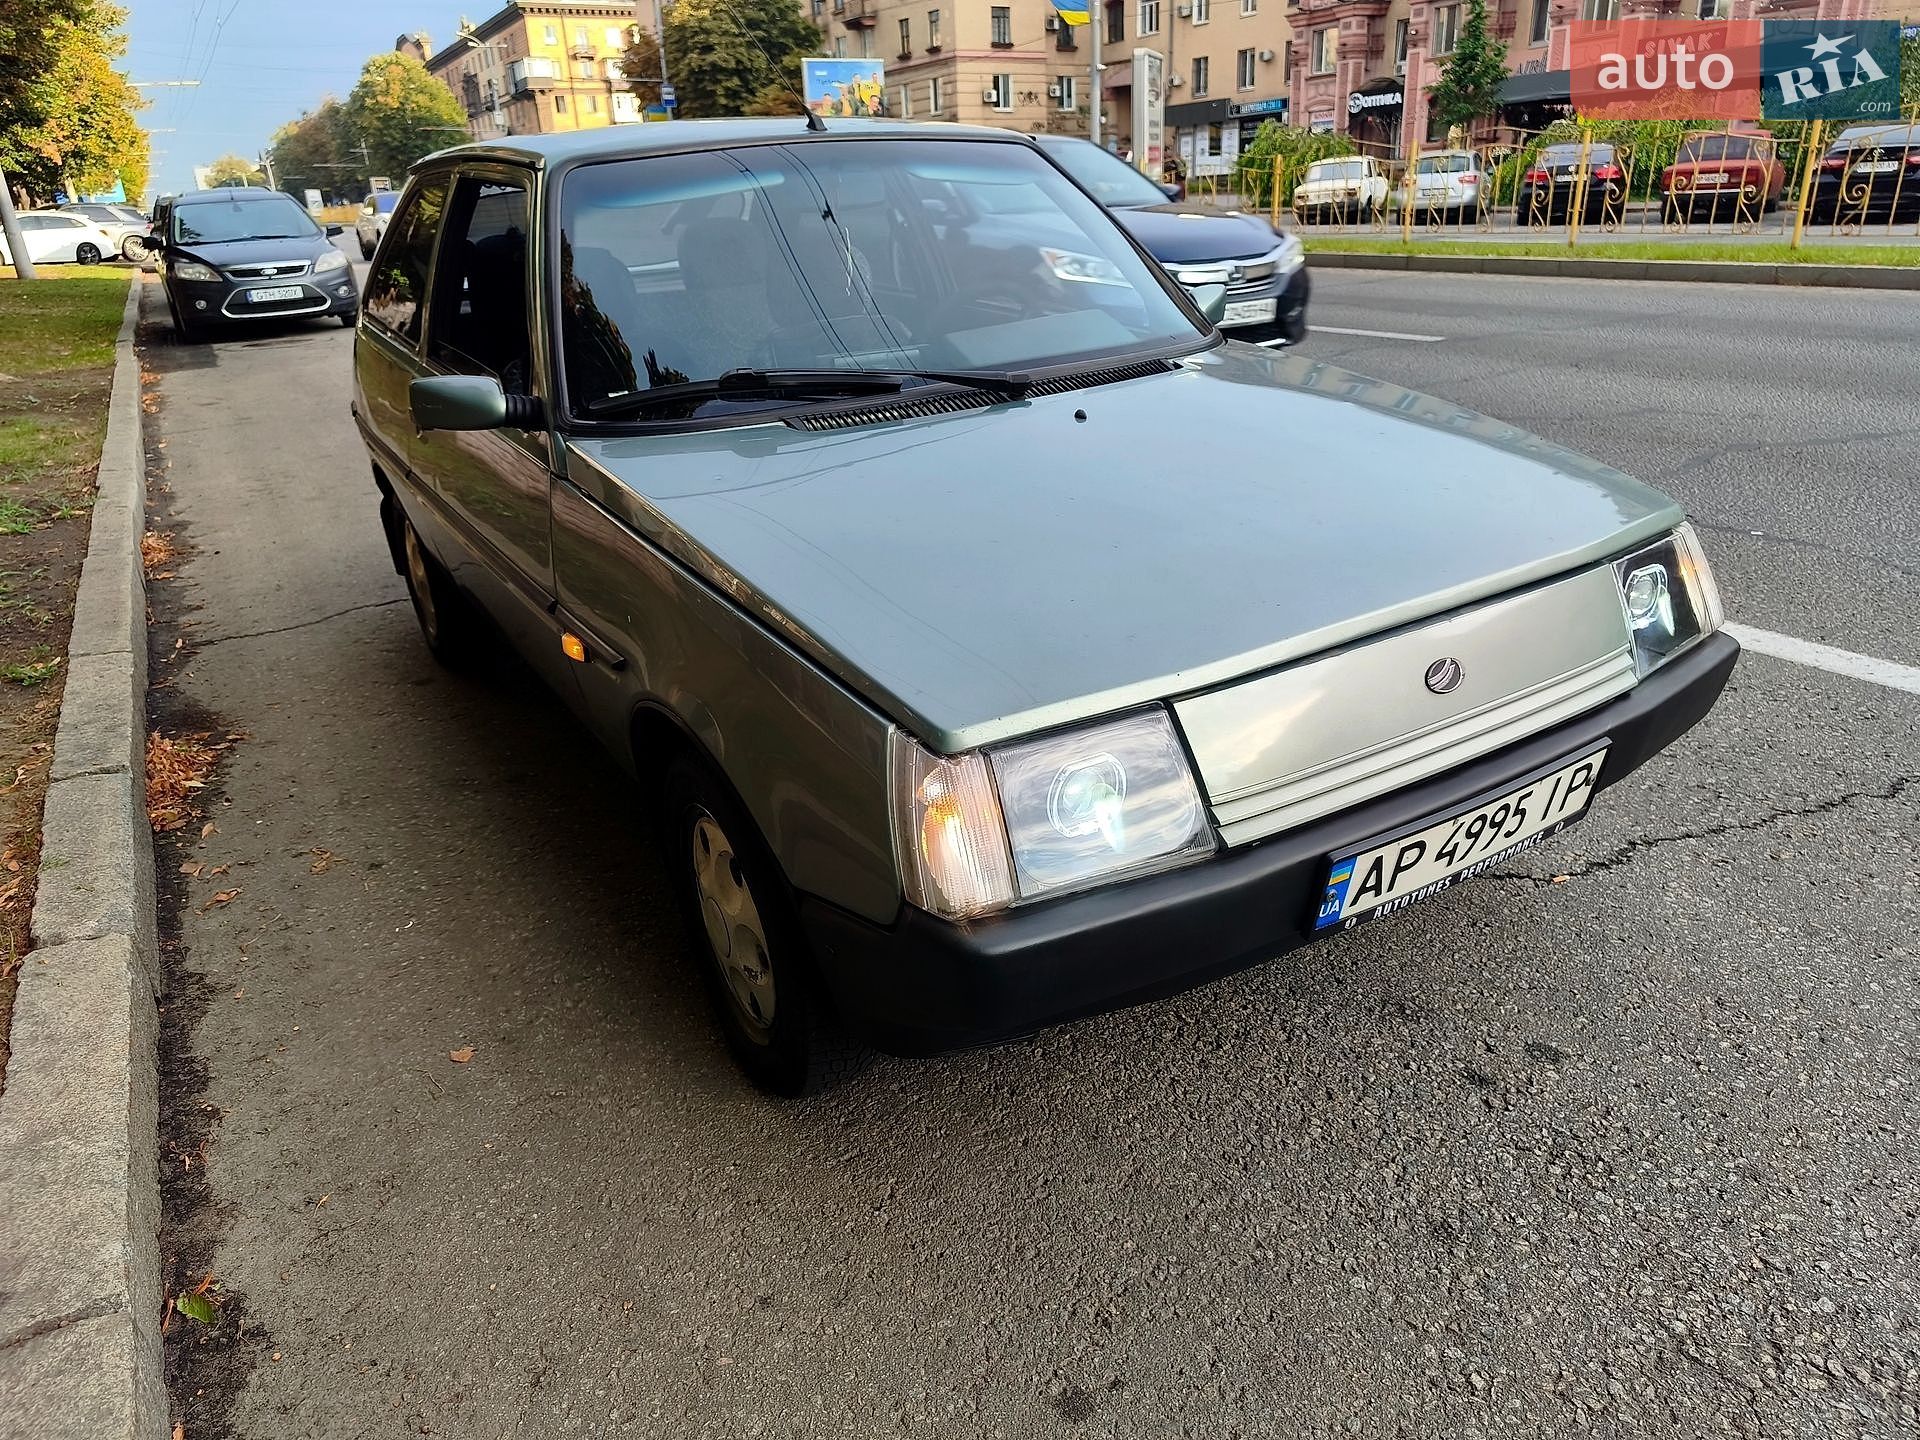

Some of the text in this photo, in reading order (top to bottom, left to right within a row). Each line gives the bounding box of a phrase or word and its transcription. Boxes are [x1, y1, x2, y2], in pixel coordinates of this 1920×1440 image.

[1319, 762, 1593, 918] UA AP 4995 IP
[1373, 831, 1545, 920] AUTOTUNES PERFORMANCE
